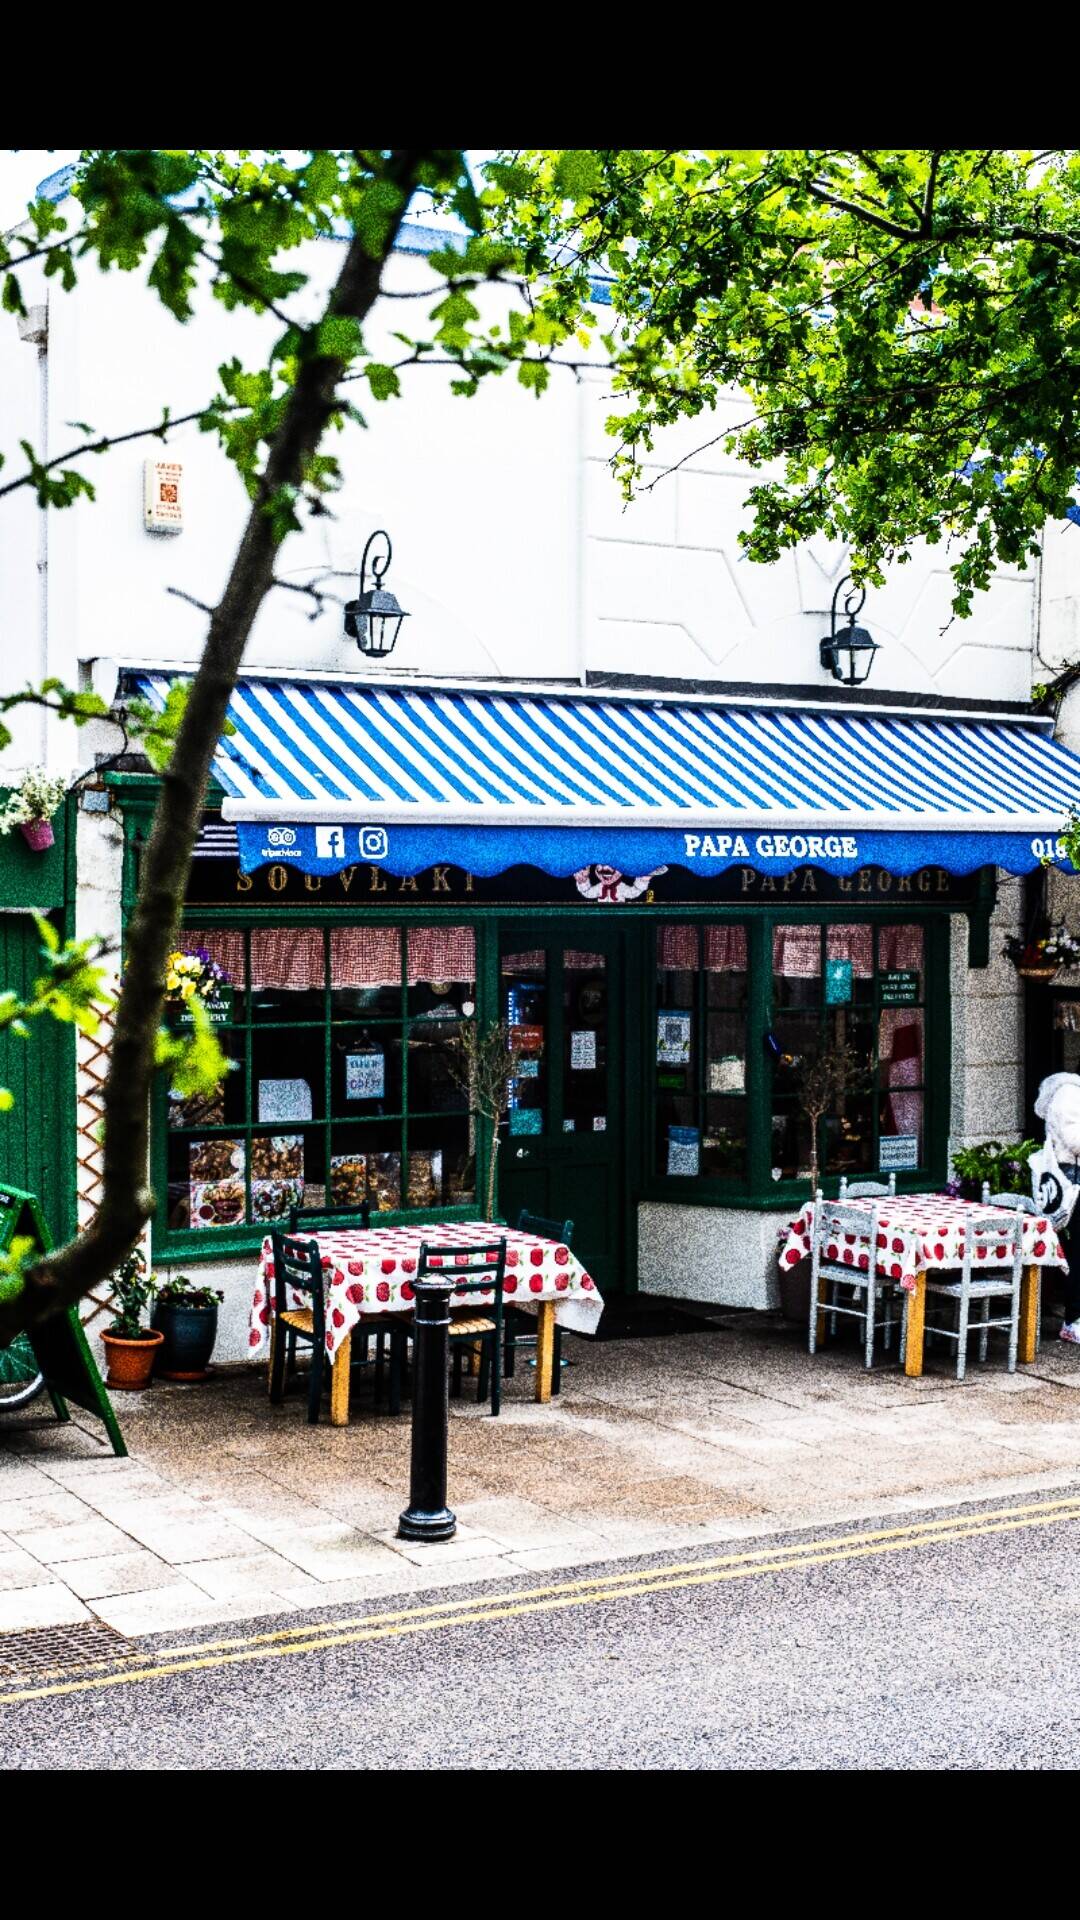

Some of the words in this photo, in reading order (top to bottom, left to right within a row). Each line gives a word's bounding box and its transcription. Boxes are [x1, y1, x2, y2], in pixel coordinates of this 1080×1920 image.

[684, 834, 750, 857] PAPA
[755, 835, 858, 858] GEORGE
[236, 865, 474, 892] SOUVLAKI
[741, 868, 818, 892] PAPA
[838, 869, 950, 893] GEORGE
[181, 1013, 228, 1022] DEERY
